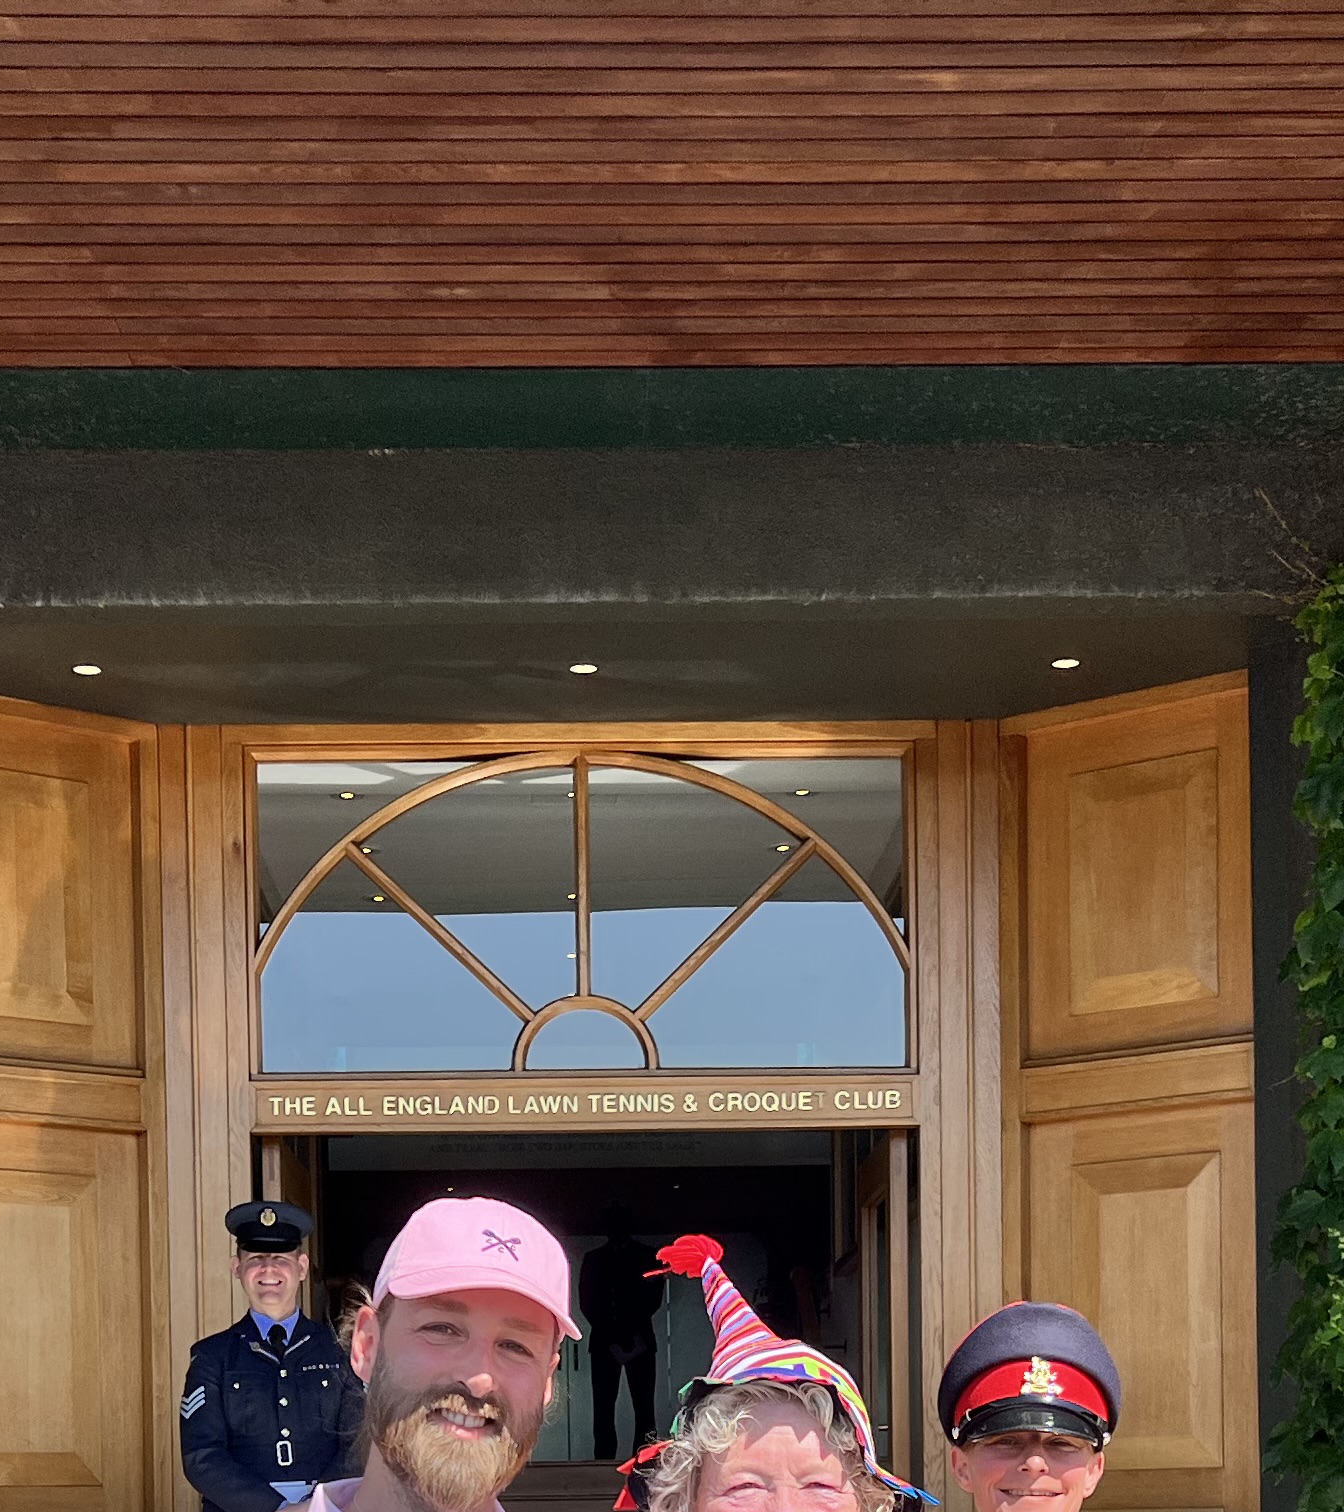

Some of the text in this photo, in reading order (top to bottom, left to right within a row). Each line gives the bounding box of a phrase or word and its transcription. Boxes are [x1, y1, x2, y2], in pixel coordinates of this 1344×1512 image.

[268, 1090, 901, 1116] THE ALL ENGLAND LAWN TENNIS & CROQUET CLUB
